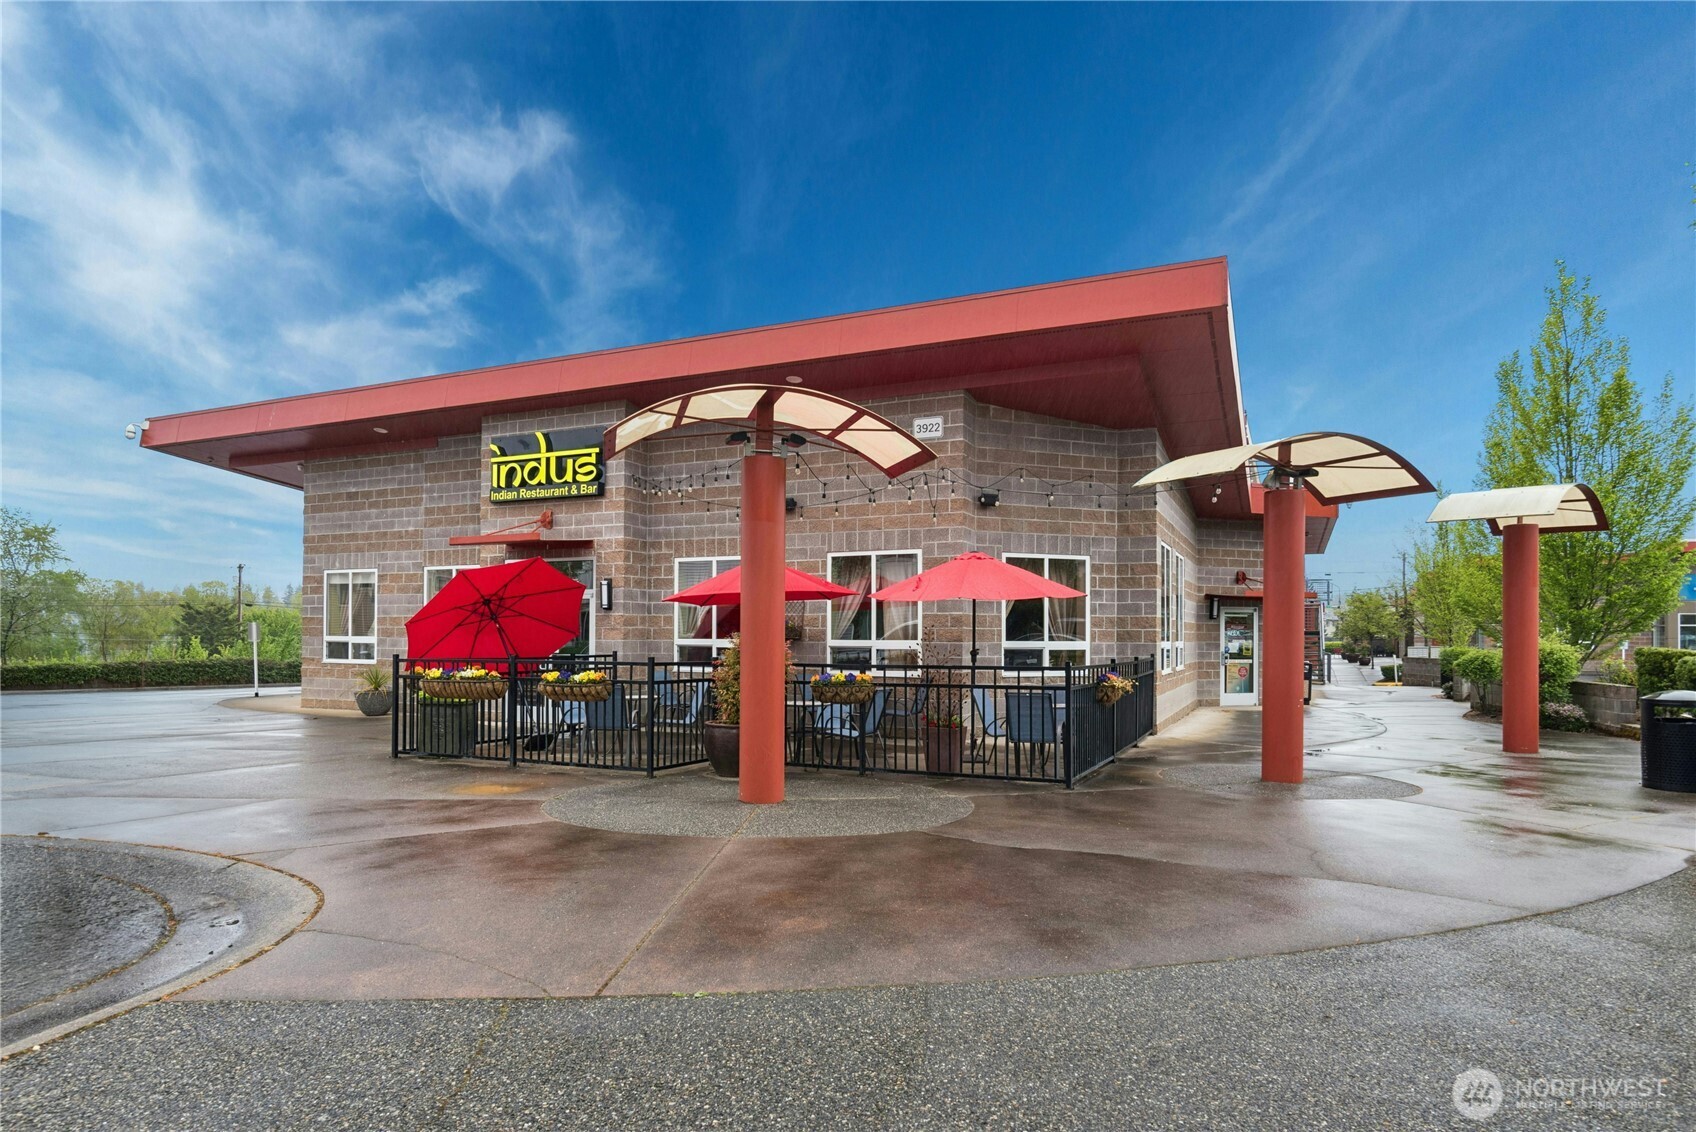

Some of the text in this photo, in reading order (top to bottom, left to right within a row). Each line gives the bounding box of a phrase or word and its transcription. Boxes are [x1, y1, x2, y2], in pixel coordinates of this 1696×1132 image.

[916, 422, 940, 433] 3922
[490, 431, 599, 488] indus
[491, 484, 597, 501] Indian Restaurant & Bar
